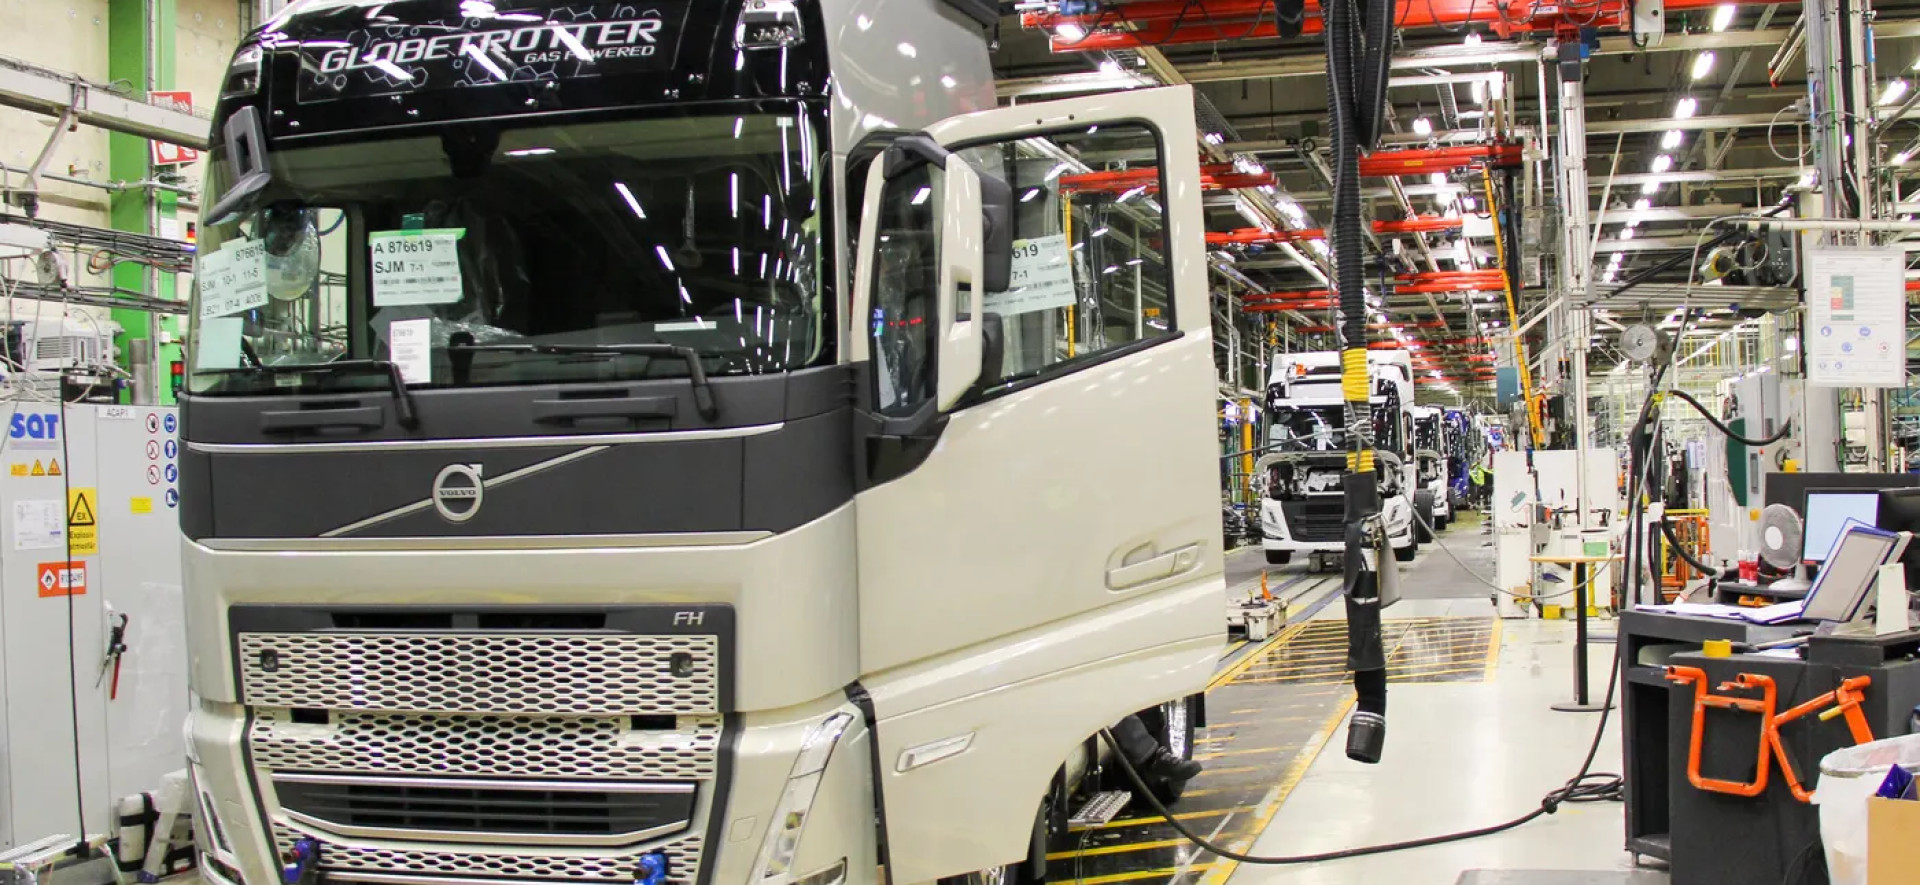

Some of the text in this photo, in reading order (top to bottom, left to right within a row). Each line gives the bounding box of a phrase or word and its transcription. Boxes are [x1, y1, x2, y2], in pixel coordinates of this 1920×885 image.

[321, 19, 662, 74] GLOBETROTTER
[524, 45, 656, 64] GAS PWERED
[374, 242, 385, 254] A
[388, 239, 433, 254] 876619
[375, 260, 405, 274] SJM
[76, 512, 87, 521] EX
[673, 611, 705, 626] FH
